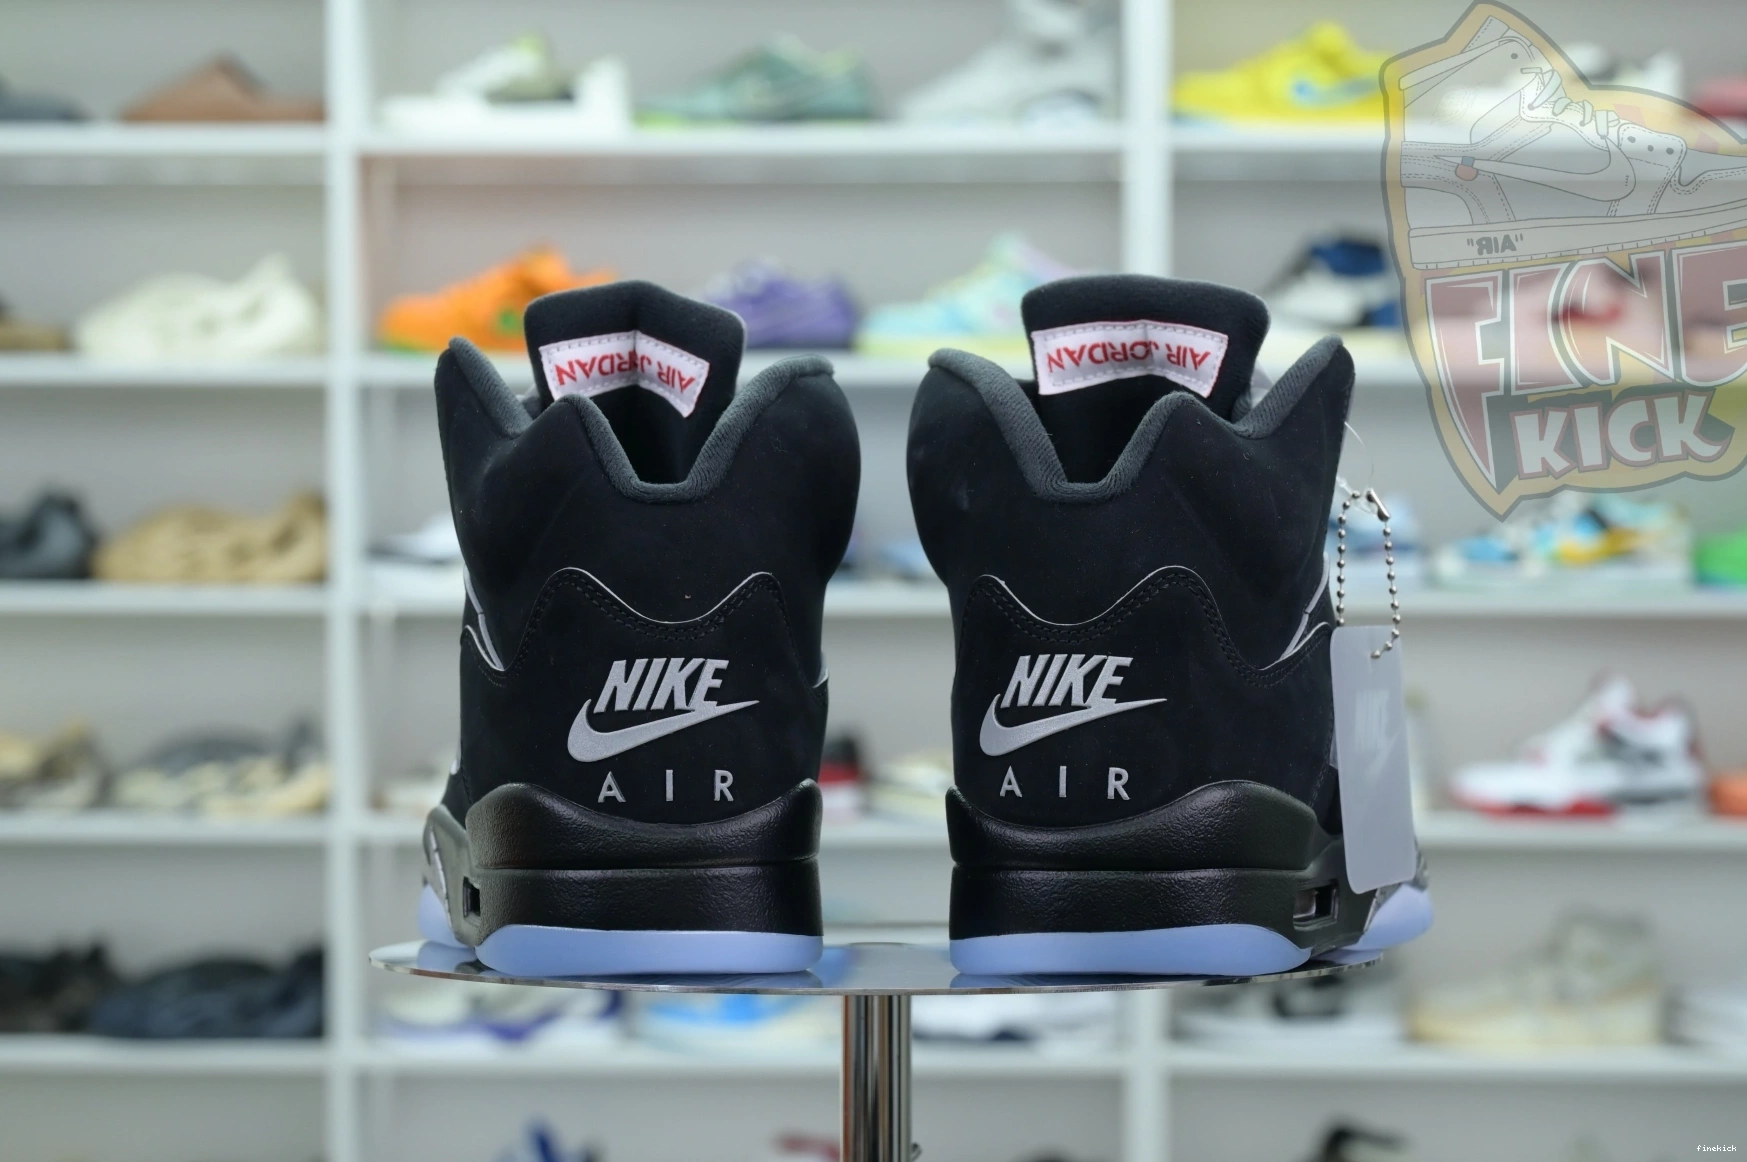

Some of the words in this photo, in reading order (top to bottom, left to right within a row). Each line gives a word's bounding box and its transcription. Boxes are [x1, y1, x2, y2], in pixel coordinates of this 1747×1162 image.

[554, 348, 652, 387] JRDAN
[657, 353, 696, 394] AIR
[1166, 343, 1211, 371] AIR
[593, 657, 730, 714] NIKE
[1000, 653, 1134, 709] NIKE
[597, 769, 735, 803] AIR
[1000, 765, 1131, 801] AIR
